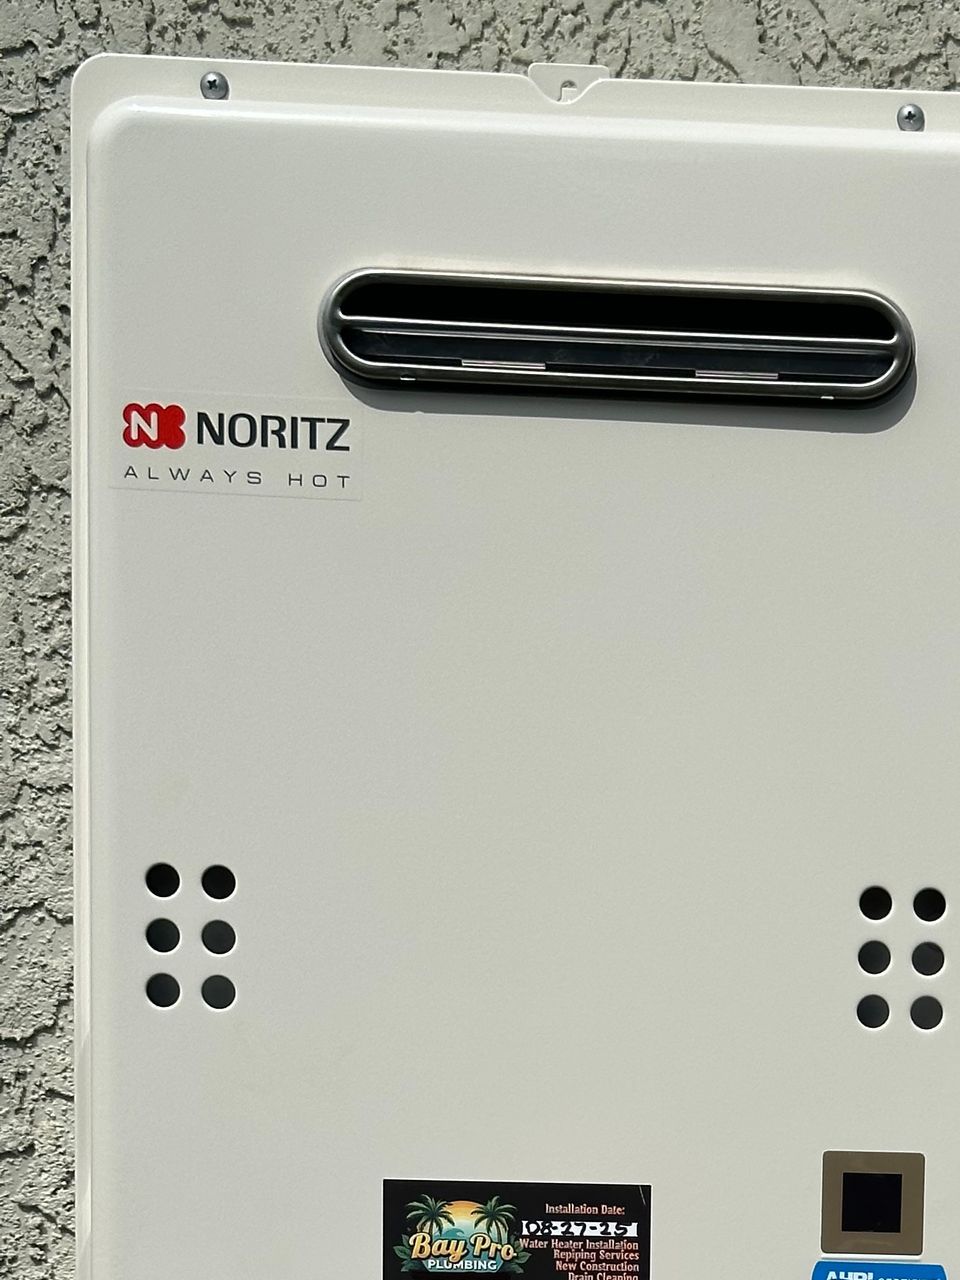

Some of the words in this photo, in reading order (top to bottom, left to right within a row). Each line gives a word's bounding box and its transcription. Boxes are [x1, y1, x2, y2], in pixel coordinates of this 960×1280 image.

[197, 412, 350, 451] NORITZ
[124, 465, 262, 485] ALWAYS
[288, 473, 350, 489] HOT
[545, 1203, 598, 1214] Installation
[601, 1204, 625, 1215] Date:
[525, 1220, 633, 1236] 08-27-25
[409, 1232, 468, 1263] Bay
[471, 1233, 518, 1260] Pro
[520, 1238, 548, 1249] Water
[551, 1239, 583, 1250] Heater
[586, 1239, 639, 1250] Installation
[553, 1249, 596, 1261] Repiping
[600, 1250, 639, 1260] Services
[428, 1259, 497, 1271] PLUMBING
[555, 1261, 577, 1271] New
[579, 1261, 639, 1272] Construction
